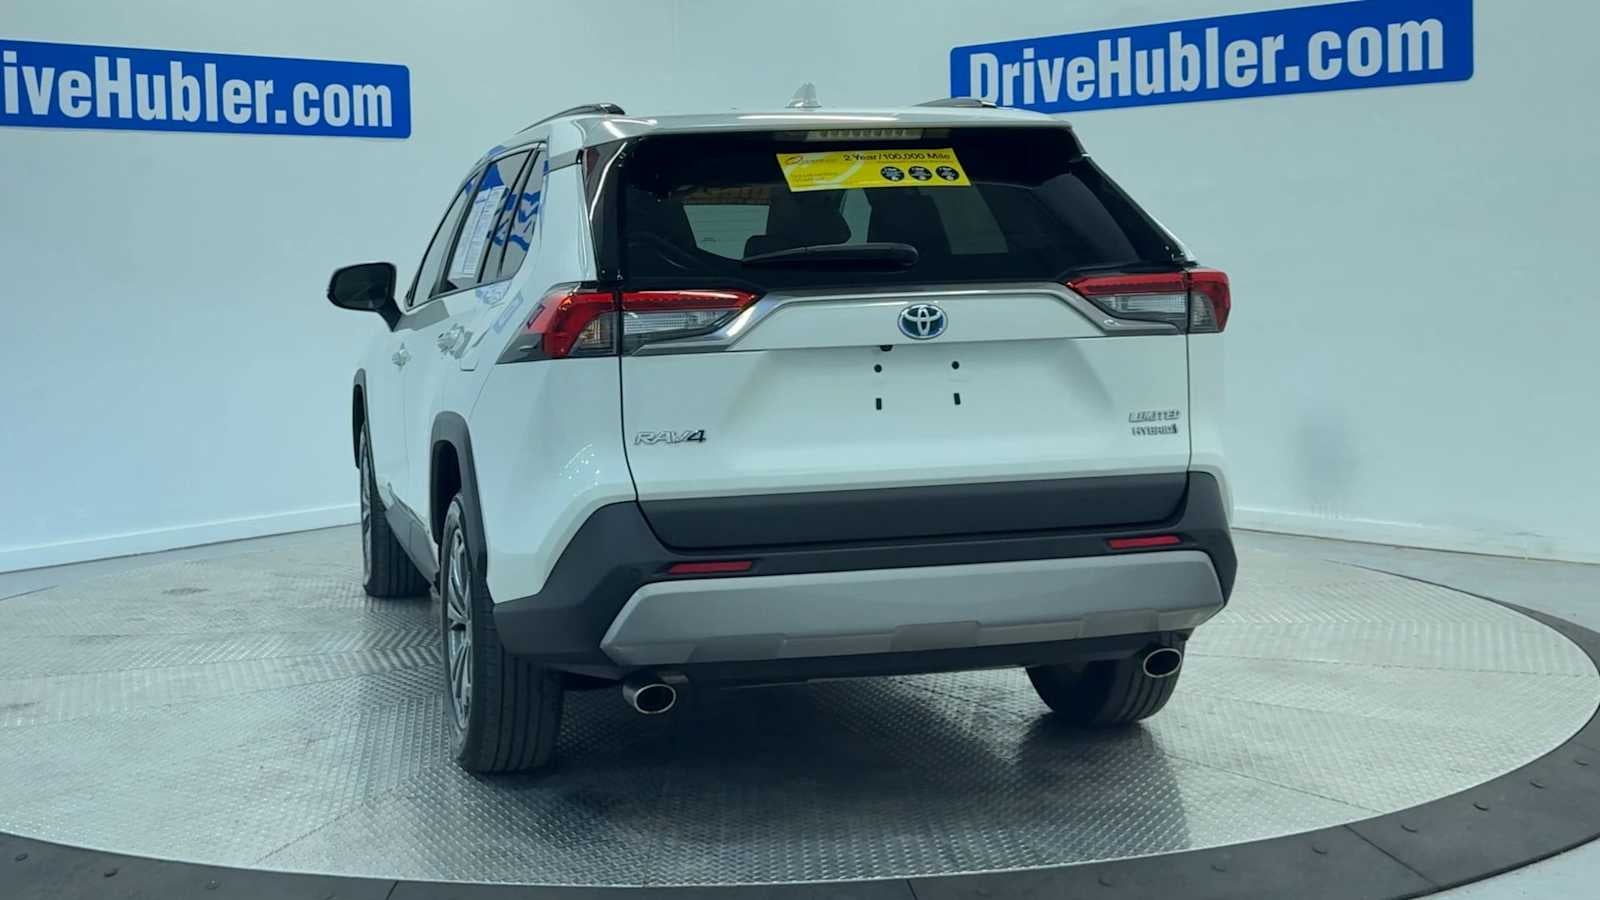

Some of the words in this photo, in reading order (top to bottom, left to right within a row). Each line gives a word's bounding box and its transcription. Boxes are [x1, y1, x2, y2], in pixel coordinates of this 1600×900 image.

[3, 50, 393, 128] iveHubler.com
[969, 17, 1444, 107] DriveHubler.com
[633, 429, 706, 446] RAV4
